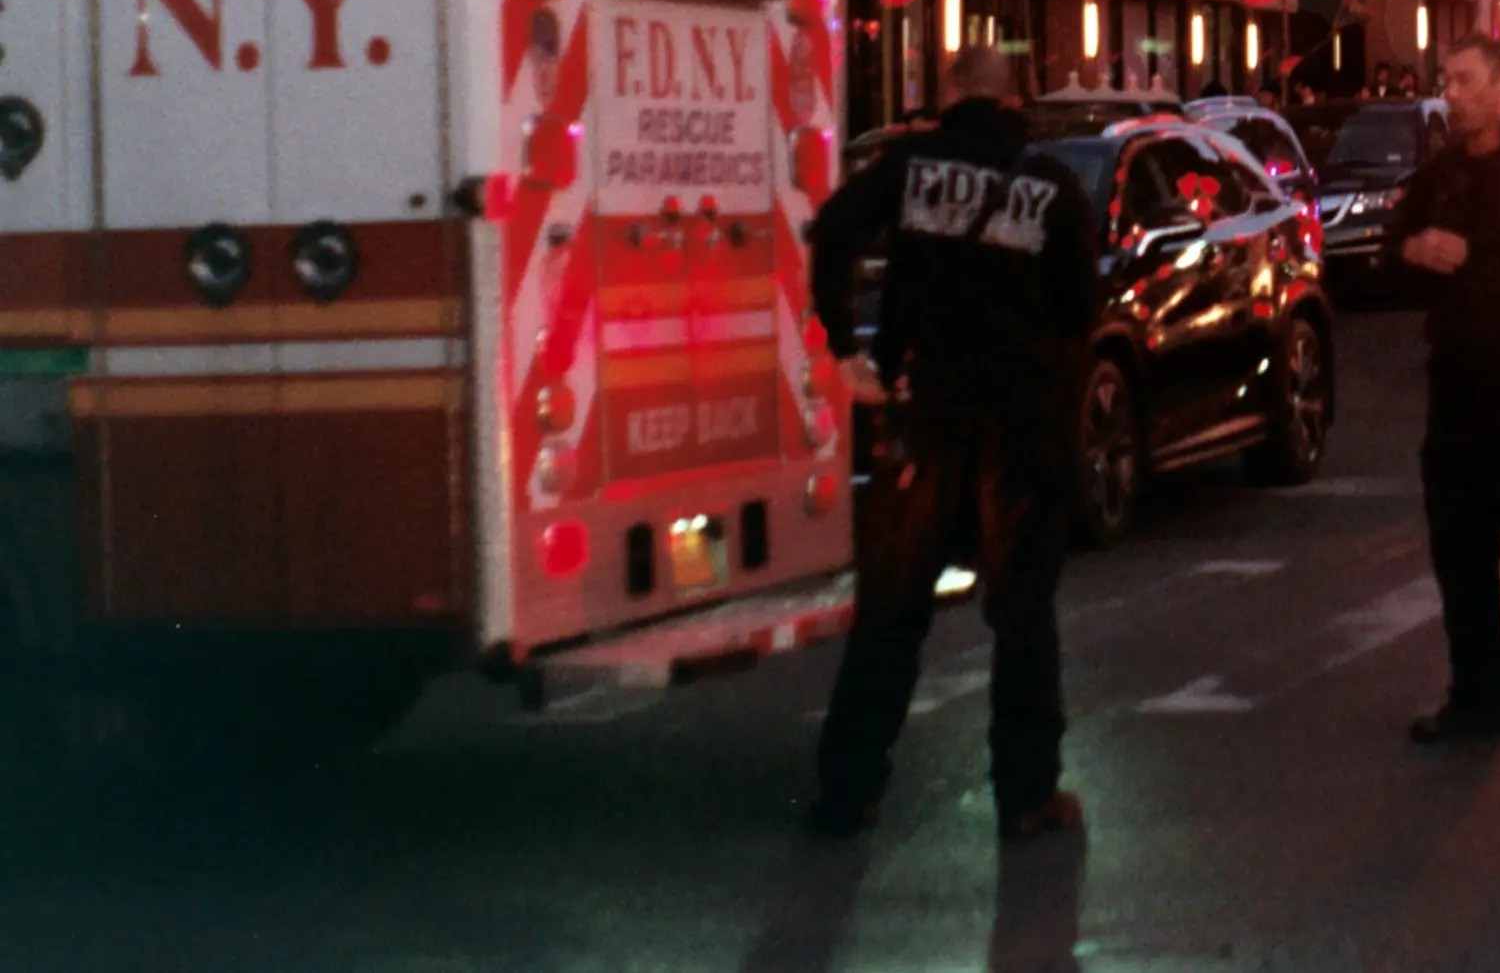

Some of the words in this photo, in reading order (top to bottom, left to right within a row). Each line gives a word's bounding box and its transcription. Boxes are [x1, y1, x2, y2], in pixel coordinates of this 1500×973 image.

[614, 16, 757, 103] F.D.N.Y.
[637, 107, 736, 144] RESCUE
[607, 150, 764, 186] PARAMEDICS
[628, 403, 690, 455] KEEP
[696, 395, 758, 445] BACK
